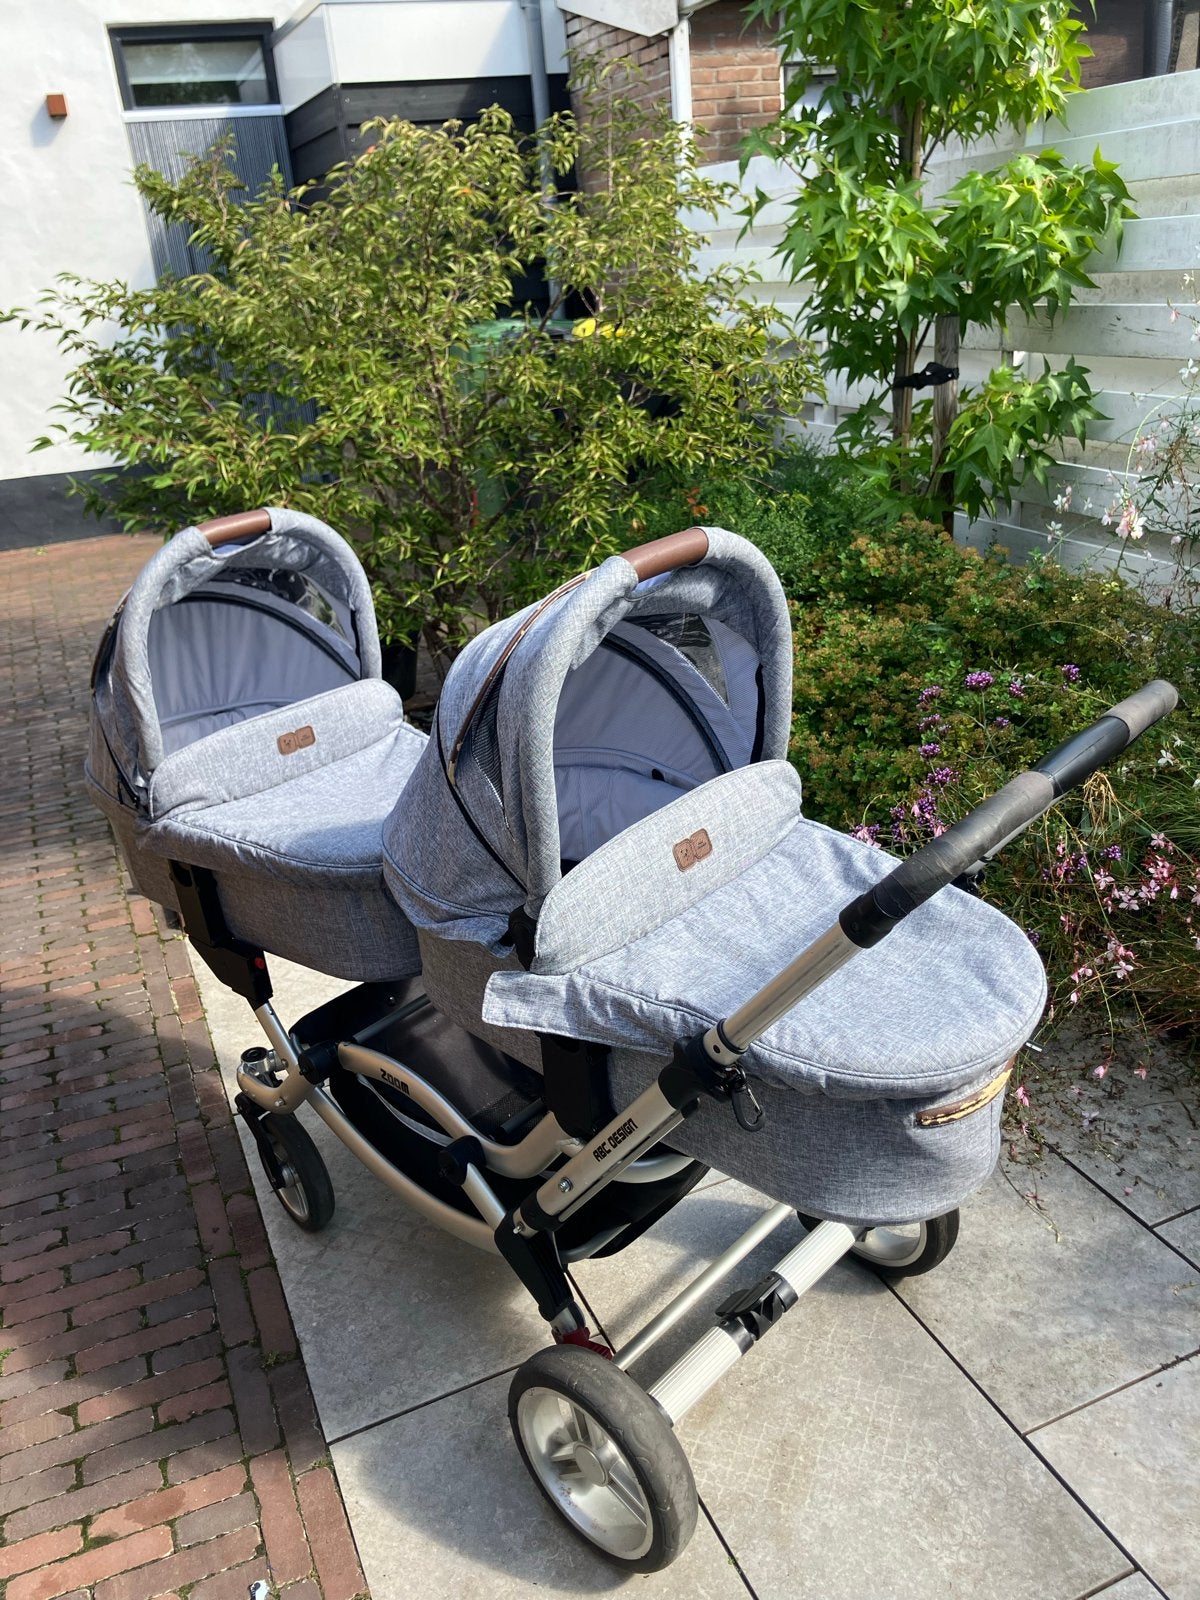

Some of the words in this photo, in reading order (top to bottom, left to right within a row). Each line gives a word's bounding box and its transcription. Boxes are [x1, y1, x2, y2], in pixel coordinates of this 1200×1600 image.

[380, 1068, 410, 1096] ZOOM
[592, 1141, 612, 1162] ABC
[607, 1118, 639, 1149] DESIGN
